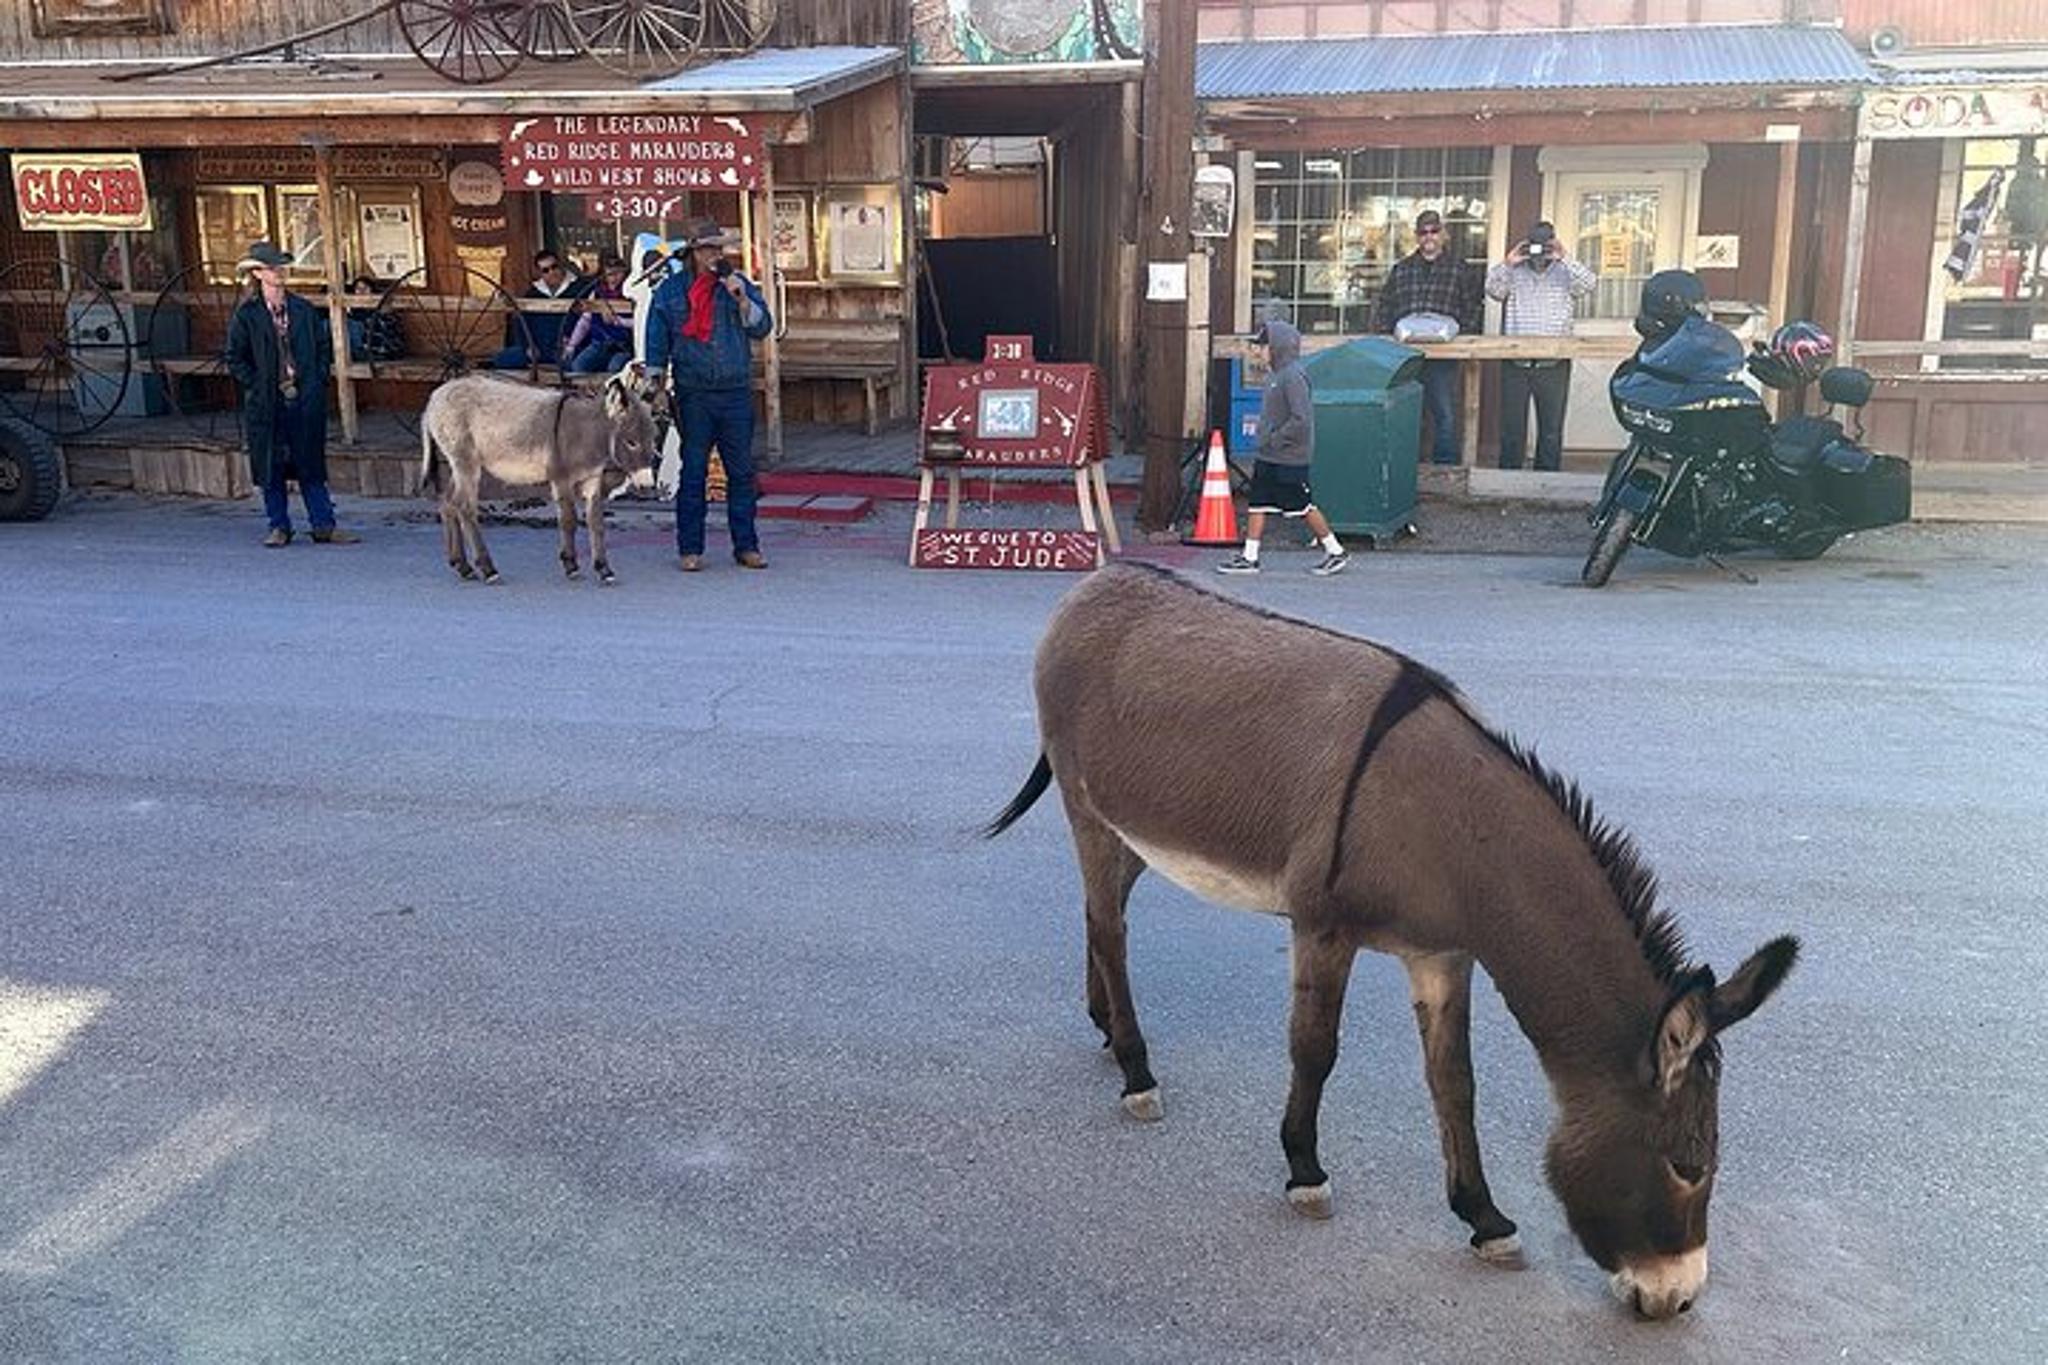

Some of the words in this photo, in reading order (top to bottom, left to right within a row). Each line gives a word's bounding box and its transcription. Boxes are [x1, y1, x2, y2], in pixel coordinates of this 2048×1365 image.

[1870, 93, 1995, 131] SODA
[554, 116, 587, 134] THE
[597, 116, 702, 134] LEGENDARY
[523, 141, 559, 160] RED
[568, 142, 621, 160] RIDGE
[630, 141, 736, 160] MARAUDERS
[551, 168, 592, 186] WILD
[599, 168, 644, 186] WEST
[653, 168, 712, 186] SHOWS
[20, 168, 143, 214] CLOSED
[610, 197, 658, 217] 3:30
[471, 216, 507, 231] CREAM
[1160, 215, 1175, 235] 4
[957, 369, 997, 389] RED
[1020, 369, 1075, 393] RIDGE
[963, 446, 1063, 462] ARAUDERS
[942, 531, 973, 544] WE
[979, 531, 1019, 544] GIVE
[1027, 531, 1057, 544] TO
[943, 546, 980, 565] ST
[989, 548, 1068, 568] JUDE
